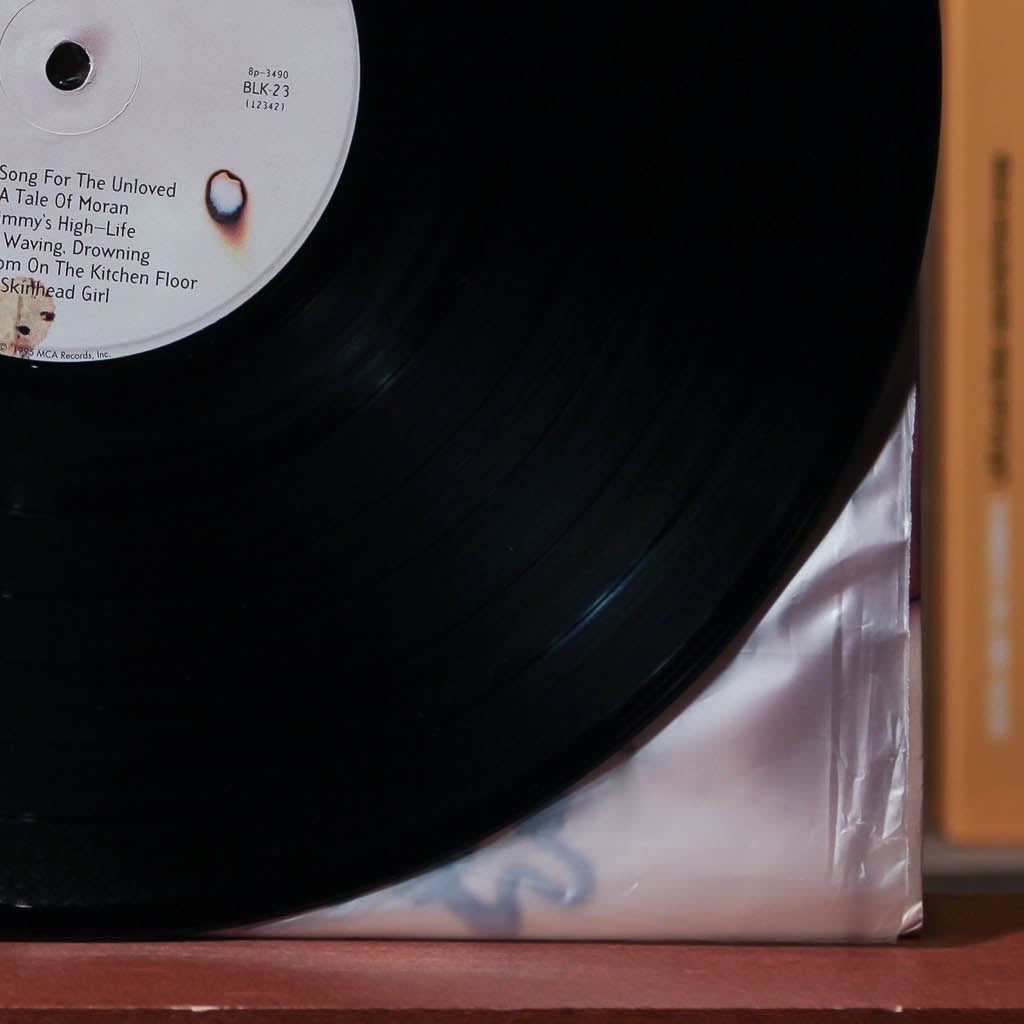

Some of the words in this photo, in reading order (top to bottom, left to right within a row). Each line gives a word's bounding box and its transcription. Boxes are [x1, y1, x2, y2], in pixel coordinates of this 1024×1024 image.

[243, 81, 289, 97] BLK-23
[0, 165, 38, 186] Song
[44, 169, 71, 186] For
[77, 173, 106, 190] The
[112, 176, 177, 198] Unloved
[16, 189, 49, 207] Tale
[55, 193, 72, 209] Of
[79, 196, 129, 215] Moran
[73, 240, 151, 266] Drowning
[28, 258, 49, 274] On
[55, 260, 84, 278] The
[91, 265, 149, 285] Kitchen
[155, 271, 198, 290] Floor
[1, 278, 75, 300] Skinhead
[82, 286, 110, 303] Girl
[37, 351, 58, 359] MCA
[61, 352, 94, 360] Records,
